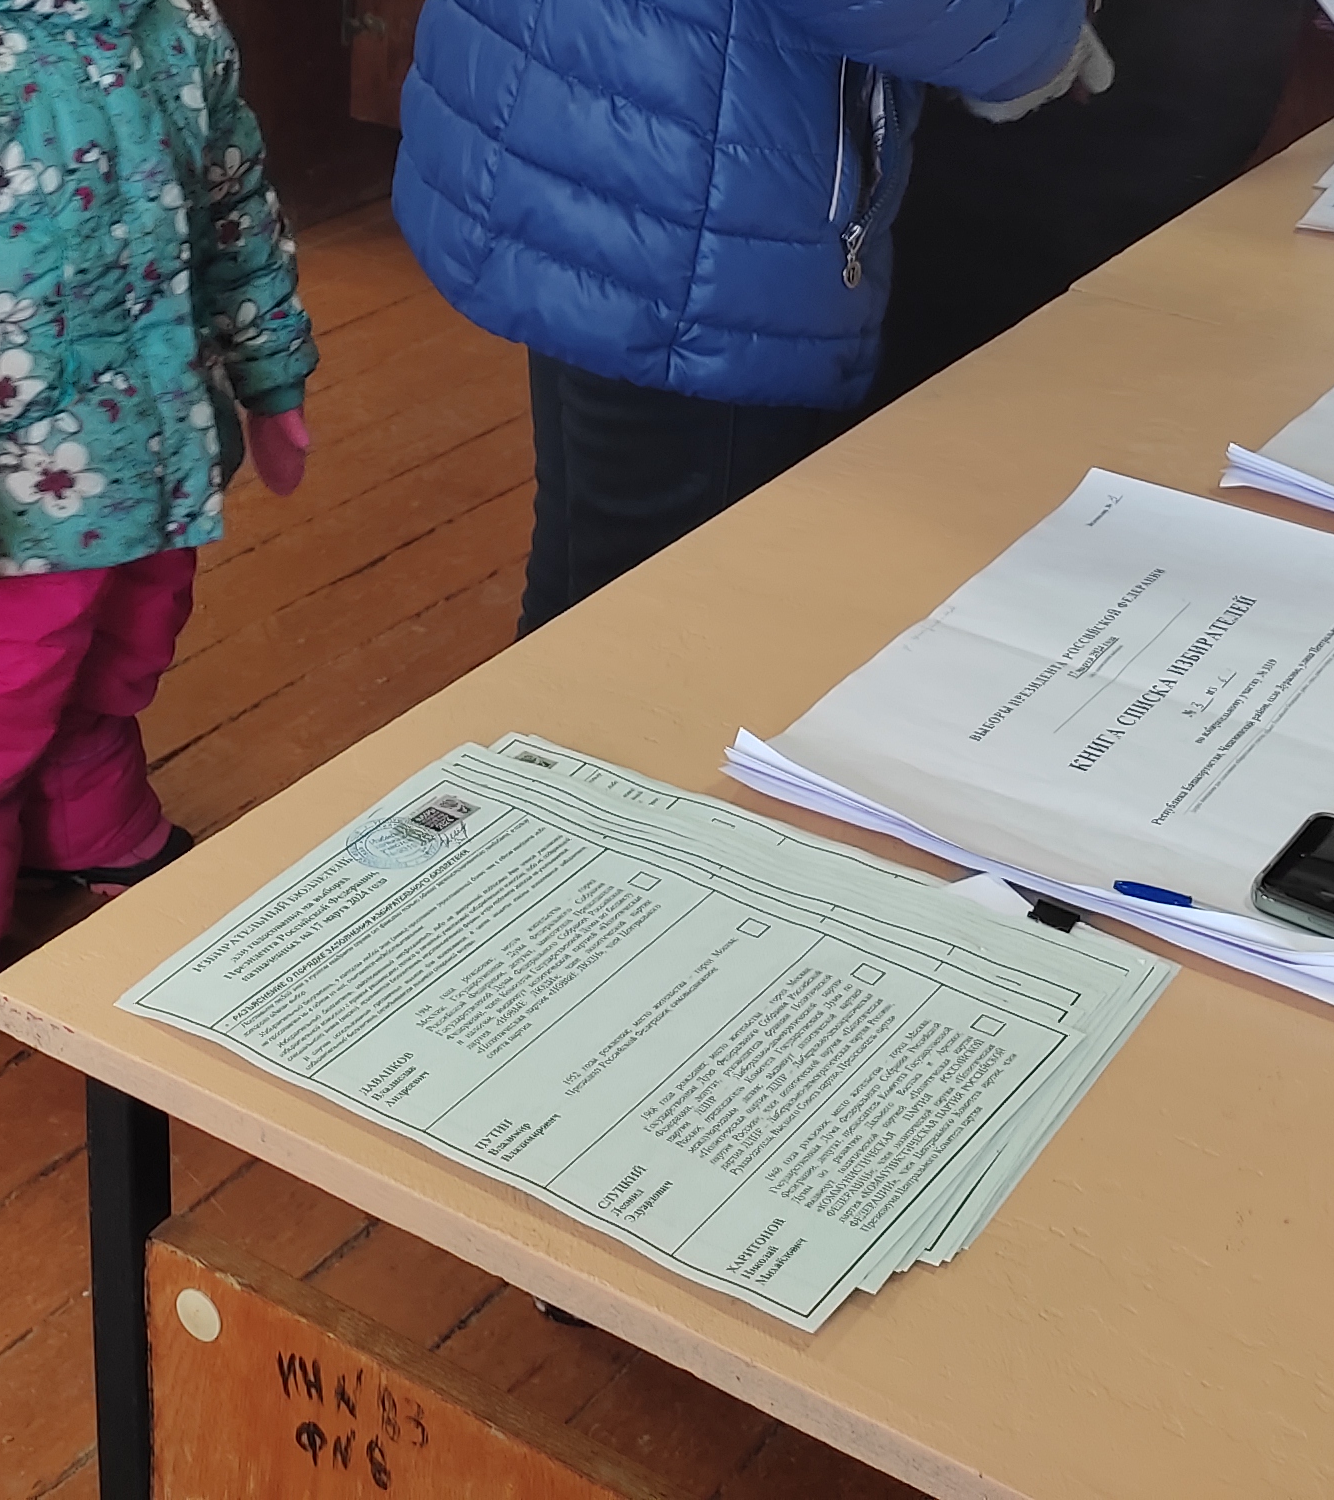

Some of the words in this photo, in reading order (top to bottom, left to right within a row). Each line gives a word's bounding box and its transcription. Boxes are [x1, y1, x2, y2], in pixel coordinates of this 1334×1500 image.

[967, 703, 1014, 743] ВЫБОРЫ
[1006, 659, 1068, 707] ПРЕЗИДЕНТА
[1060, 607, 1122, 660] РОССИЙСКОЙ
[1114, 567, 1167, 609] ФЕДЕРАЦИИ
[1066, 723, 1127, 775] КНИГА
[1111, 674, 1182, 729] СПИСКА
[1164, 593, 1259, 677] ИЗБИРАТЕЛЕЙ
[190, 899, 292, 973] ИЗБИРАТЕЛЬНЫЙ
[286, 855, 355, 902] БЮЛЛЕТЕНЬ
[221, 939, 281, 980] Президента
[274, 902, 331, 941] Российской
[324, 867, 381, 906] Федерации,
[227, 947, 251, 963] для
[245, 909, 304, 950] голосования
[299, 901, 317, 911] на
[308, 874, 353, 903] выборах
[229, 980, 288, 1022] РАЗЪЯСНЕНИЕ
[282, 975, 296, 983] О
[290, 951, 328, 978] ПОРЯДКЕ
[322, 918, 374, 954] ЗАПОЛНЕНИЯ
[368, 875, 433, 922] ИЗБИРАТЕЛЬНОГО
[426, 847, 471, 879] БЮЛЛЕТЕНЯ
[238, 938, 302, 982] назначенных
[297, 929, 315, 940] на
[307, 921, 325, 931] 17
[319, 903, 352, 925] марта
[344, 888, 370, 905] 2024
[365, 876, 389, 892] года
[356, 1049, 417, 1096] ДАВАНКОВ
[369, 1063, 419, 1102] Владислав
[381, 1068, 433, 1108] Андреевич
[473, 1117, 516, 1151] ПУТИН
[487, 1120, 534, 1157] Владимир
[500, 1111, 563, 1163] Владимирович
[593, 1163, 649, 1210] СЛУЦКИЙ
[609, 1186, 646, 1217] Леонид
[623, 1178, 677, 1224] Эдуардович
[723, 1215, 787, 1275] ХАРИТОНОВ
[738, 1243, 780, 1280] Николай
[753, 1235, 809, 1287] Михайлович
